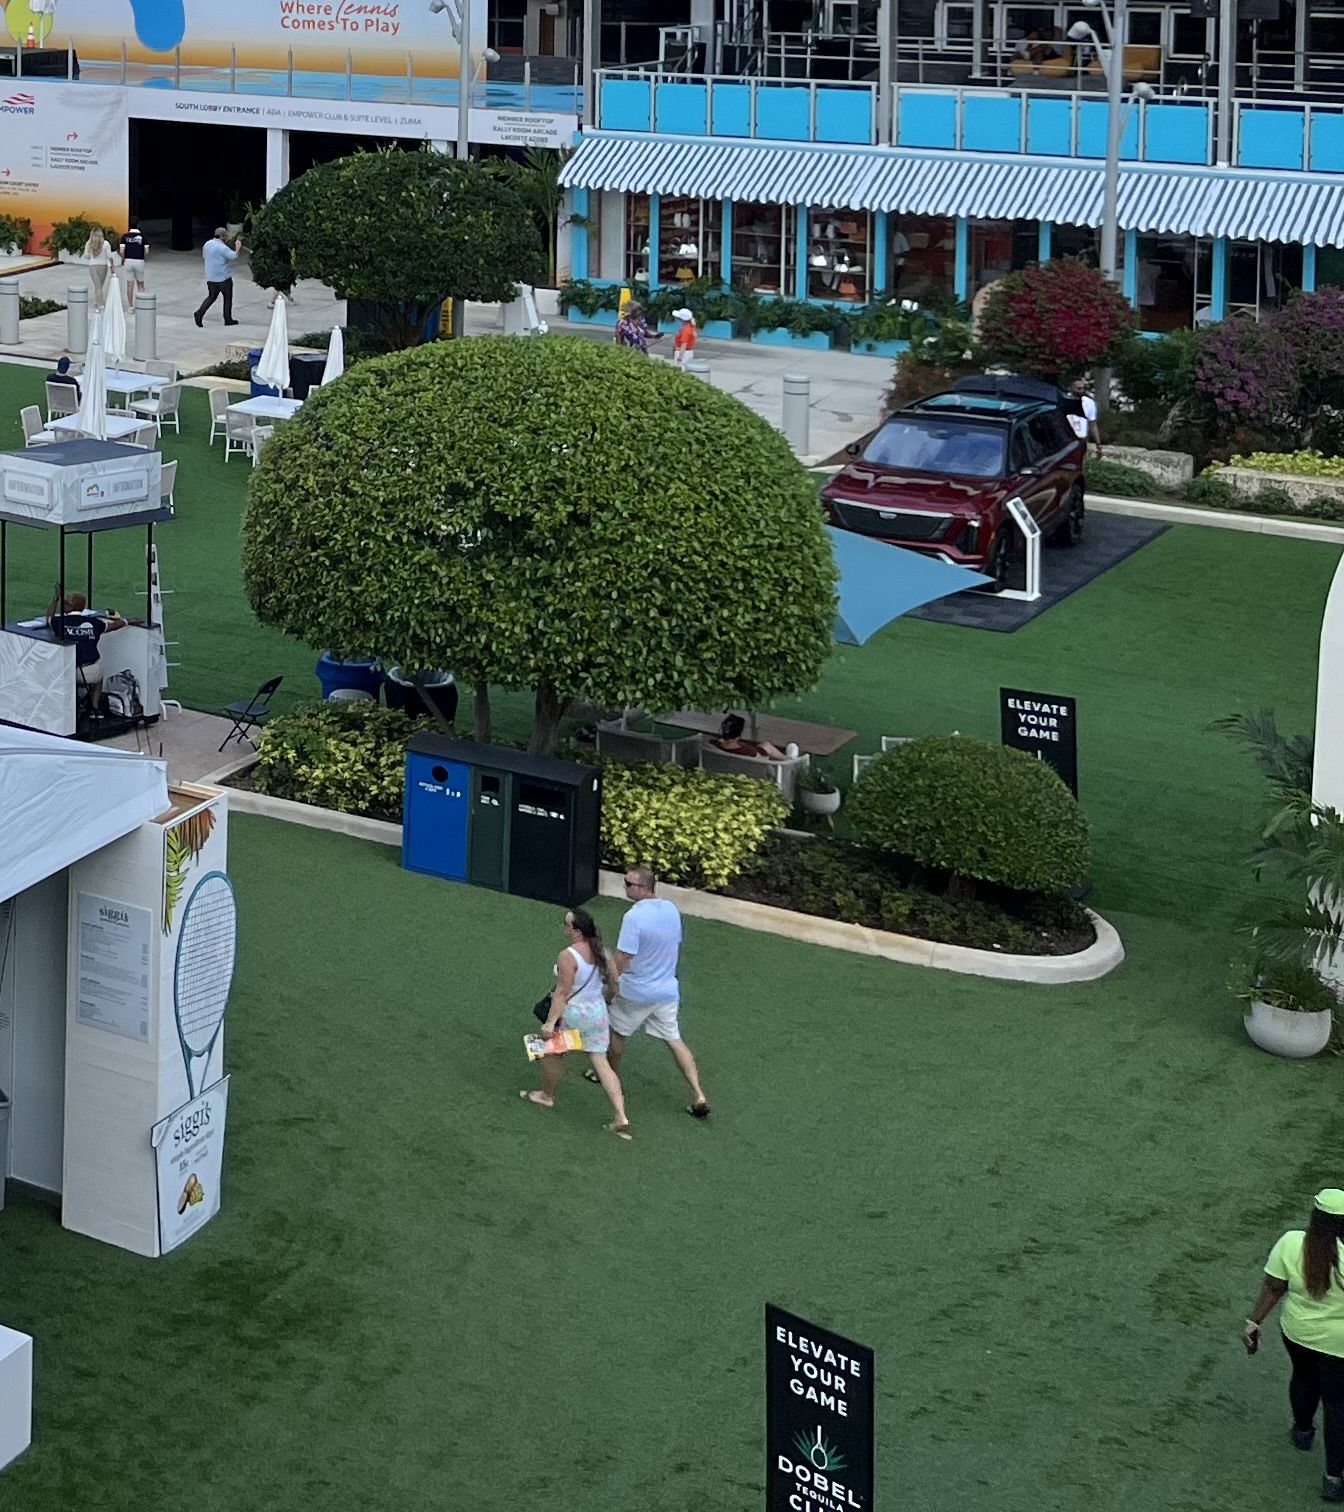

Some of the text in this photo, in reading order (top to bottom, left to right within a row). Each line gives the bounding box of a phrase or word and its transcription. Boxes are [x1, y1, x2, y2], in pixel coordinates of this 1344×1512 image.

[280, 0, 333, 15] Where
[280, 15, 401, 37] Comes To Play
[223, 105, 260, 115] ENTRANCE
[1007, 698, 1068, 717] ELEVATE
[1018, 712, 1058, 728] YOUR
[1017, 726, 1060, 742] GAME
[776, 1325, 861, 1378] ELEVATE
[790, 1354, 846, 1394] YOUR
[789, 1378, 848, 1417] GAME
[777, 1455, 861, 1509] DOBEL
[795, 1482, 844, 1512] TEQUILA
